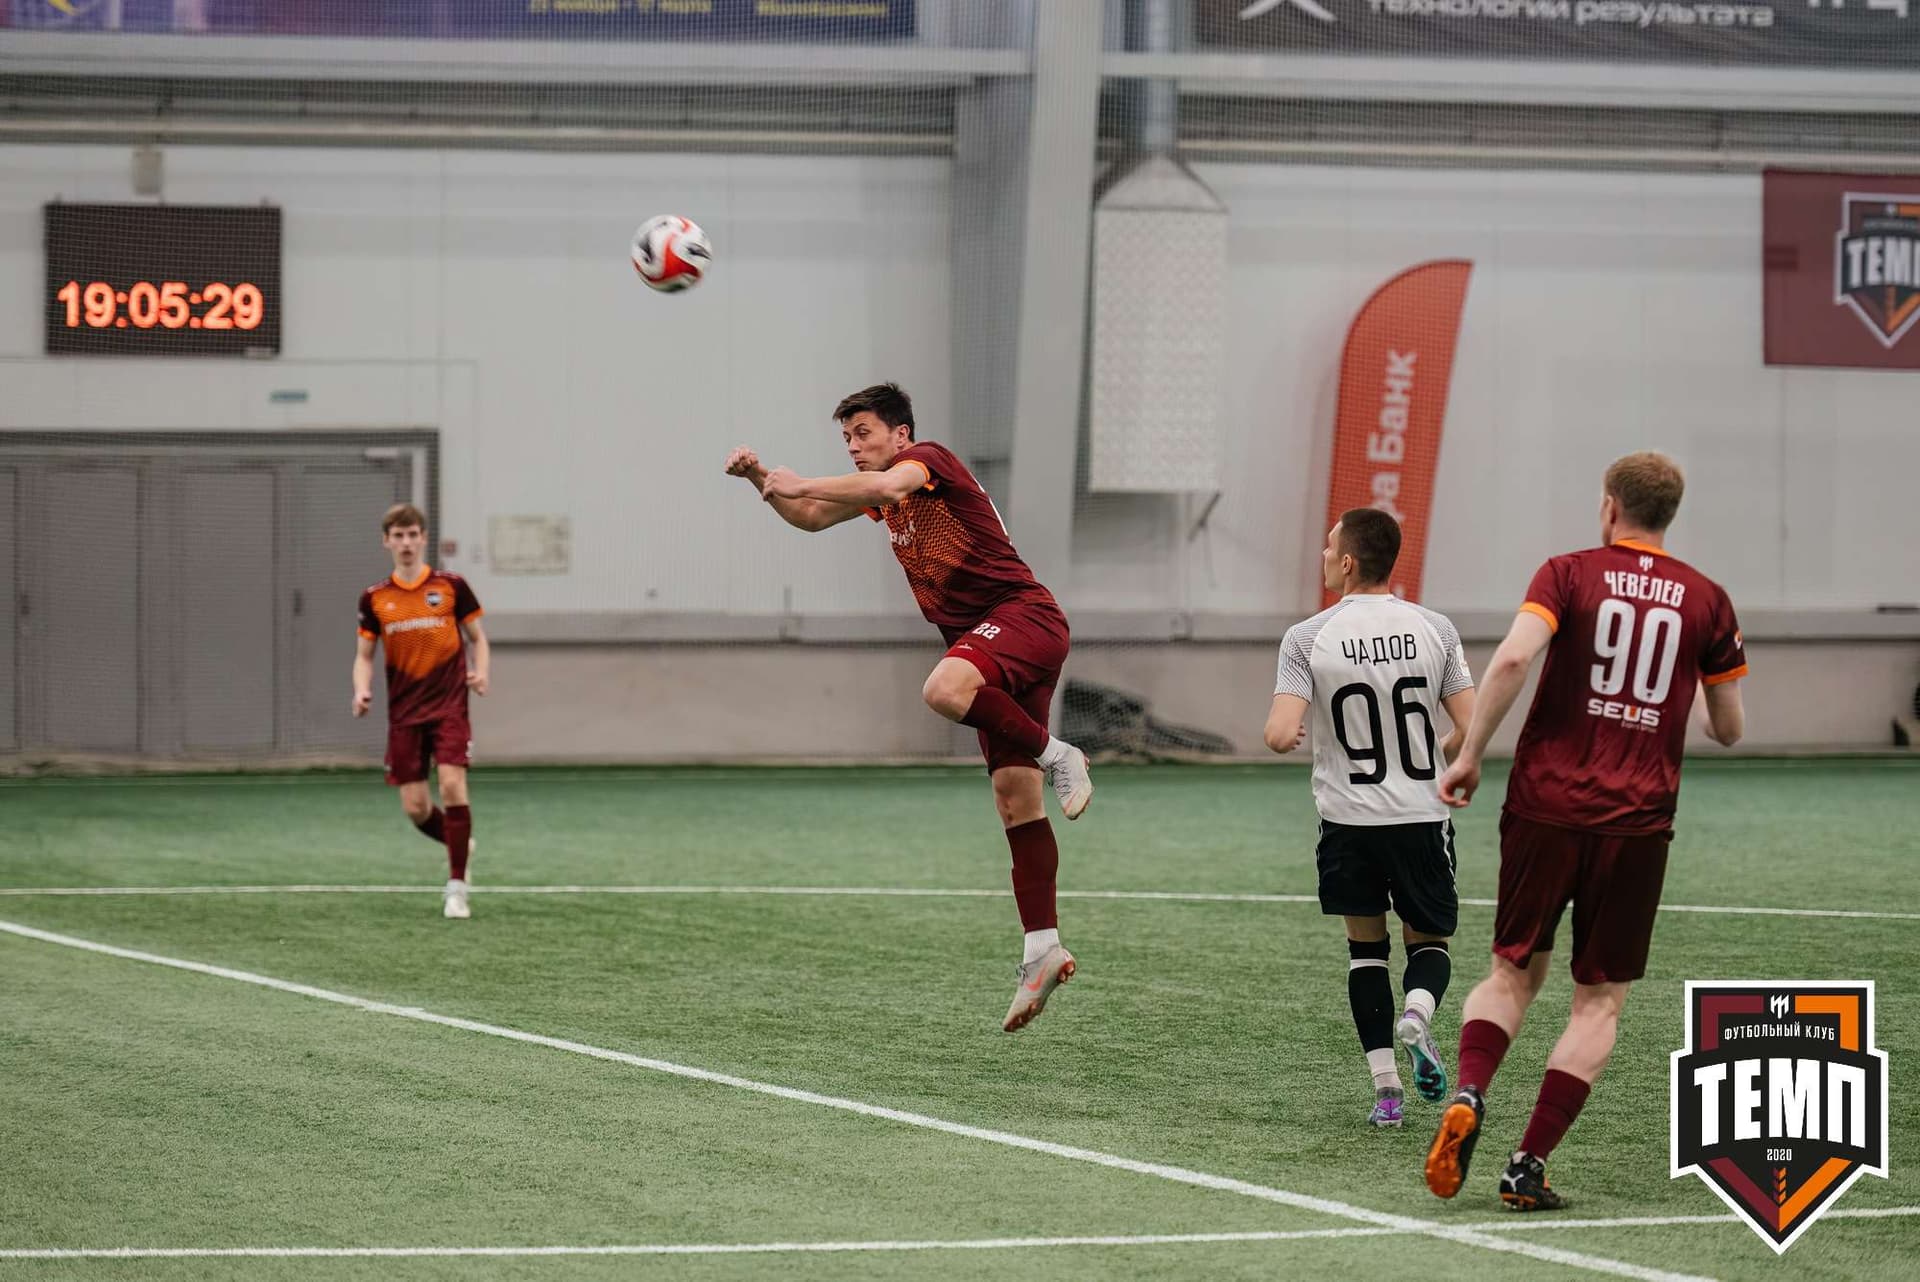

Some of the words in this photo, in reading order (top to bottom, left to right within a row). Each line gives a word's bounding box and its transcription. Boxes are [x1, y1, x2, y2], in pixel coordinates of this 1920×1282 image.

[1575, 3, 1774, 28] результата
[1846, 236, 1920, 288] ТЕМ
[57, 280, 264, 329] 19:05:29
[1367, 350, 1417, 464] Банк
[1604, 570, 1685, 608] ЧЕВЕЛЕВ
[972, 622, 1001, 640] 22
[1341, 633, 1417, 666] ЧАДОВ
[1590, 598, 1683, 705] 90
[1331, 676, 1436, 785] 96
[1587, 698, 1661, 728] SEUS
